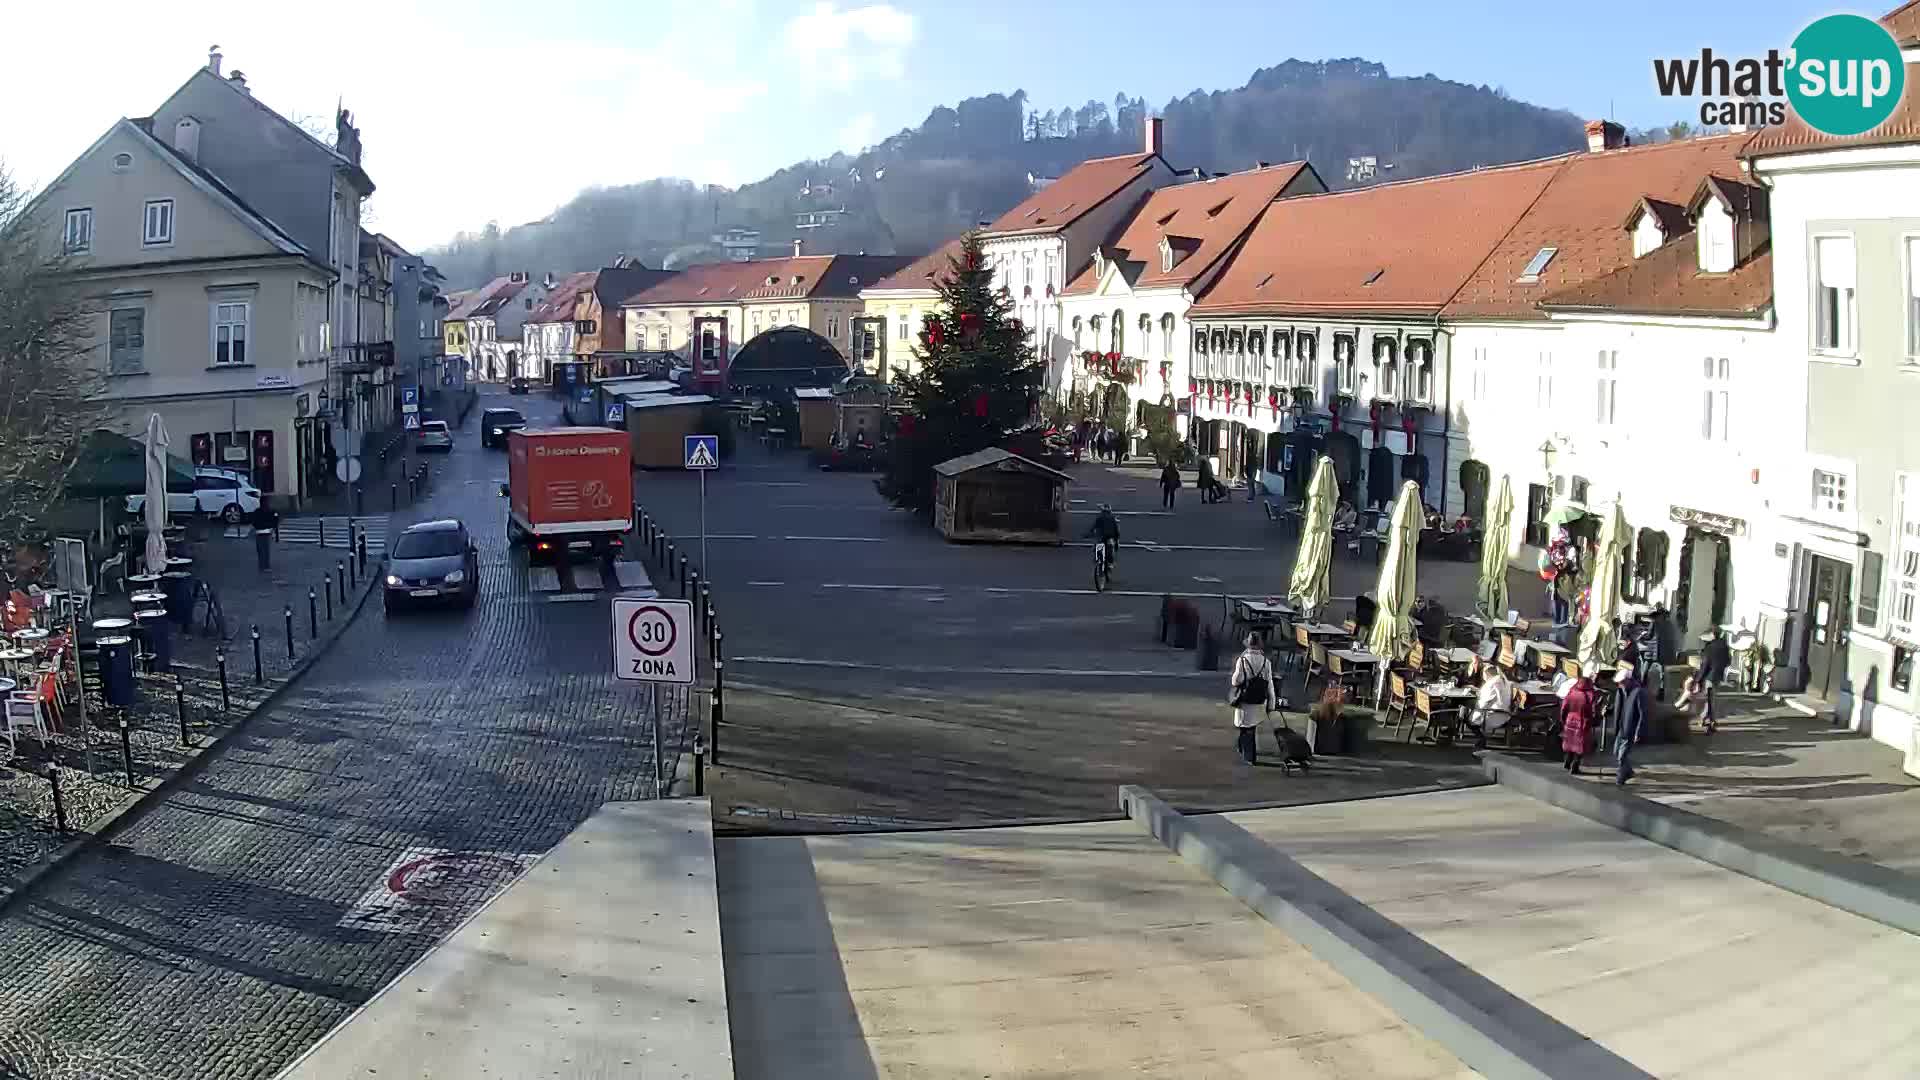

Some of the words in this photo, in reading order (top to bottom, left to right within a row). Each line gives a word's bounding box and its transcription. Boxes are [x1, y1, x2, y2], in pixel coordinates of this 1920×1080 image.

[406, 391, 414, 402] P
[641, 622, 665, 642] 30
[631, 659, 676, 676] ZONA
